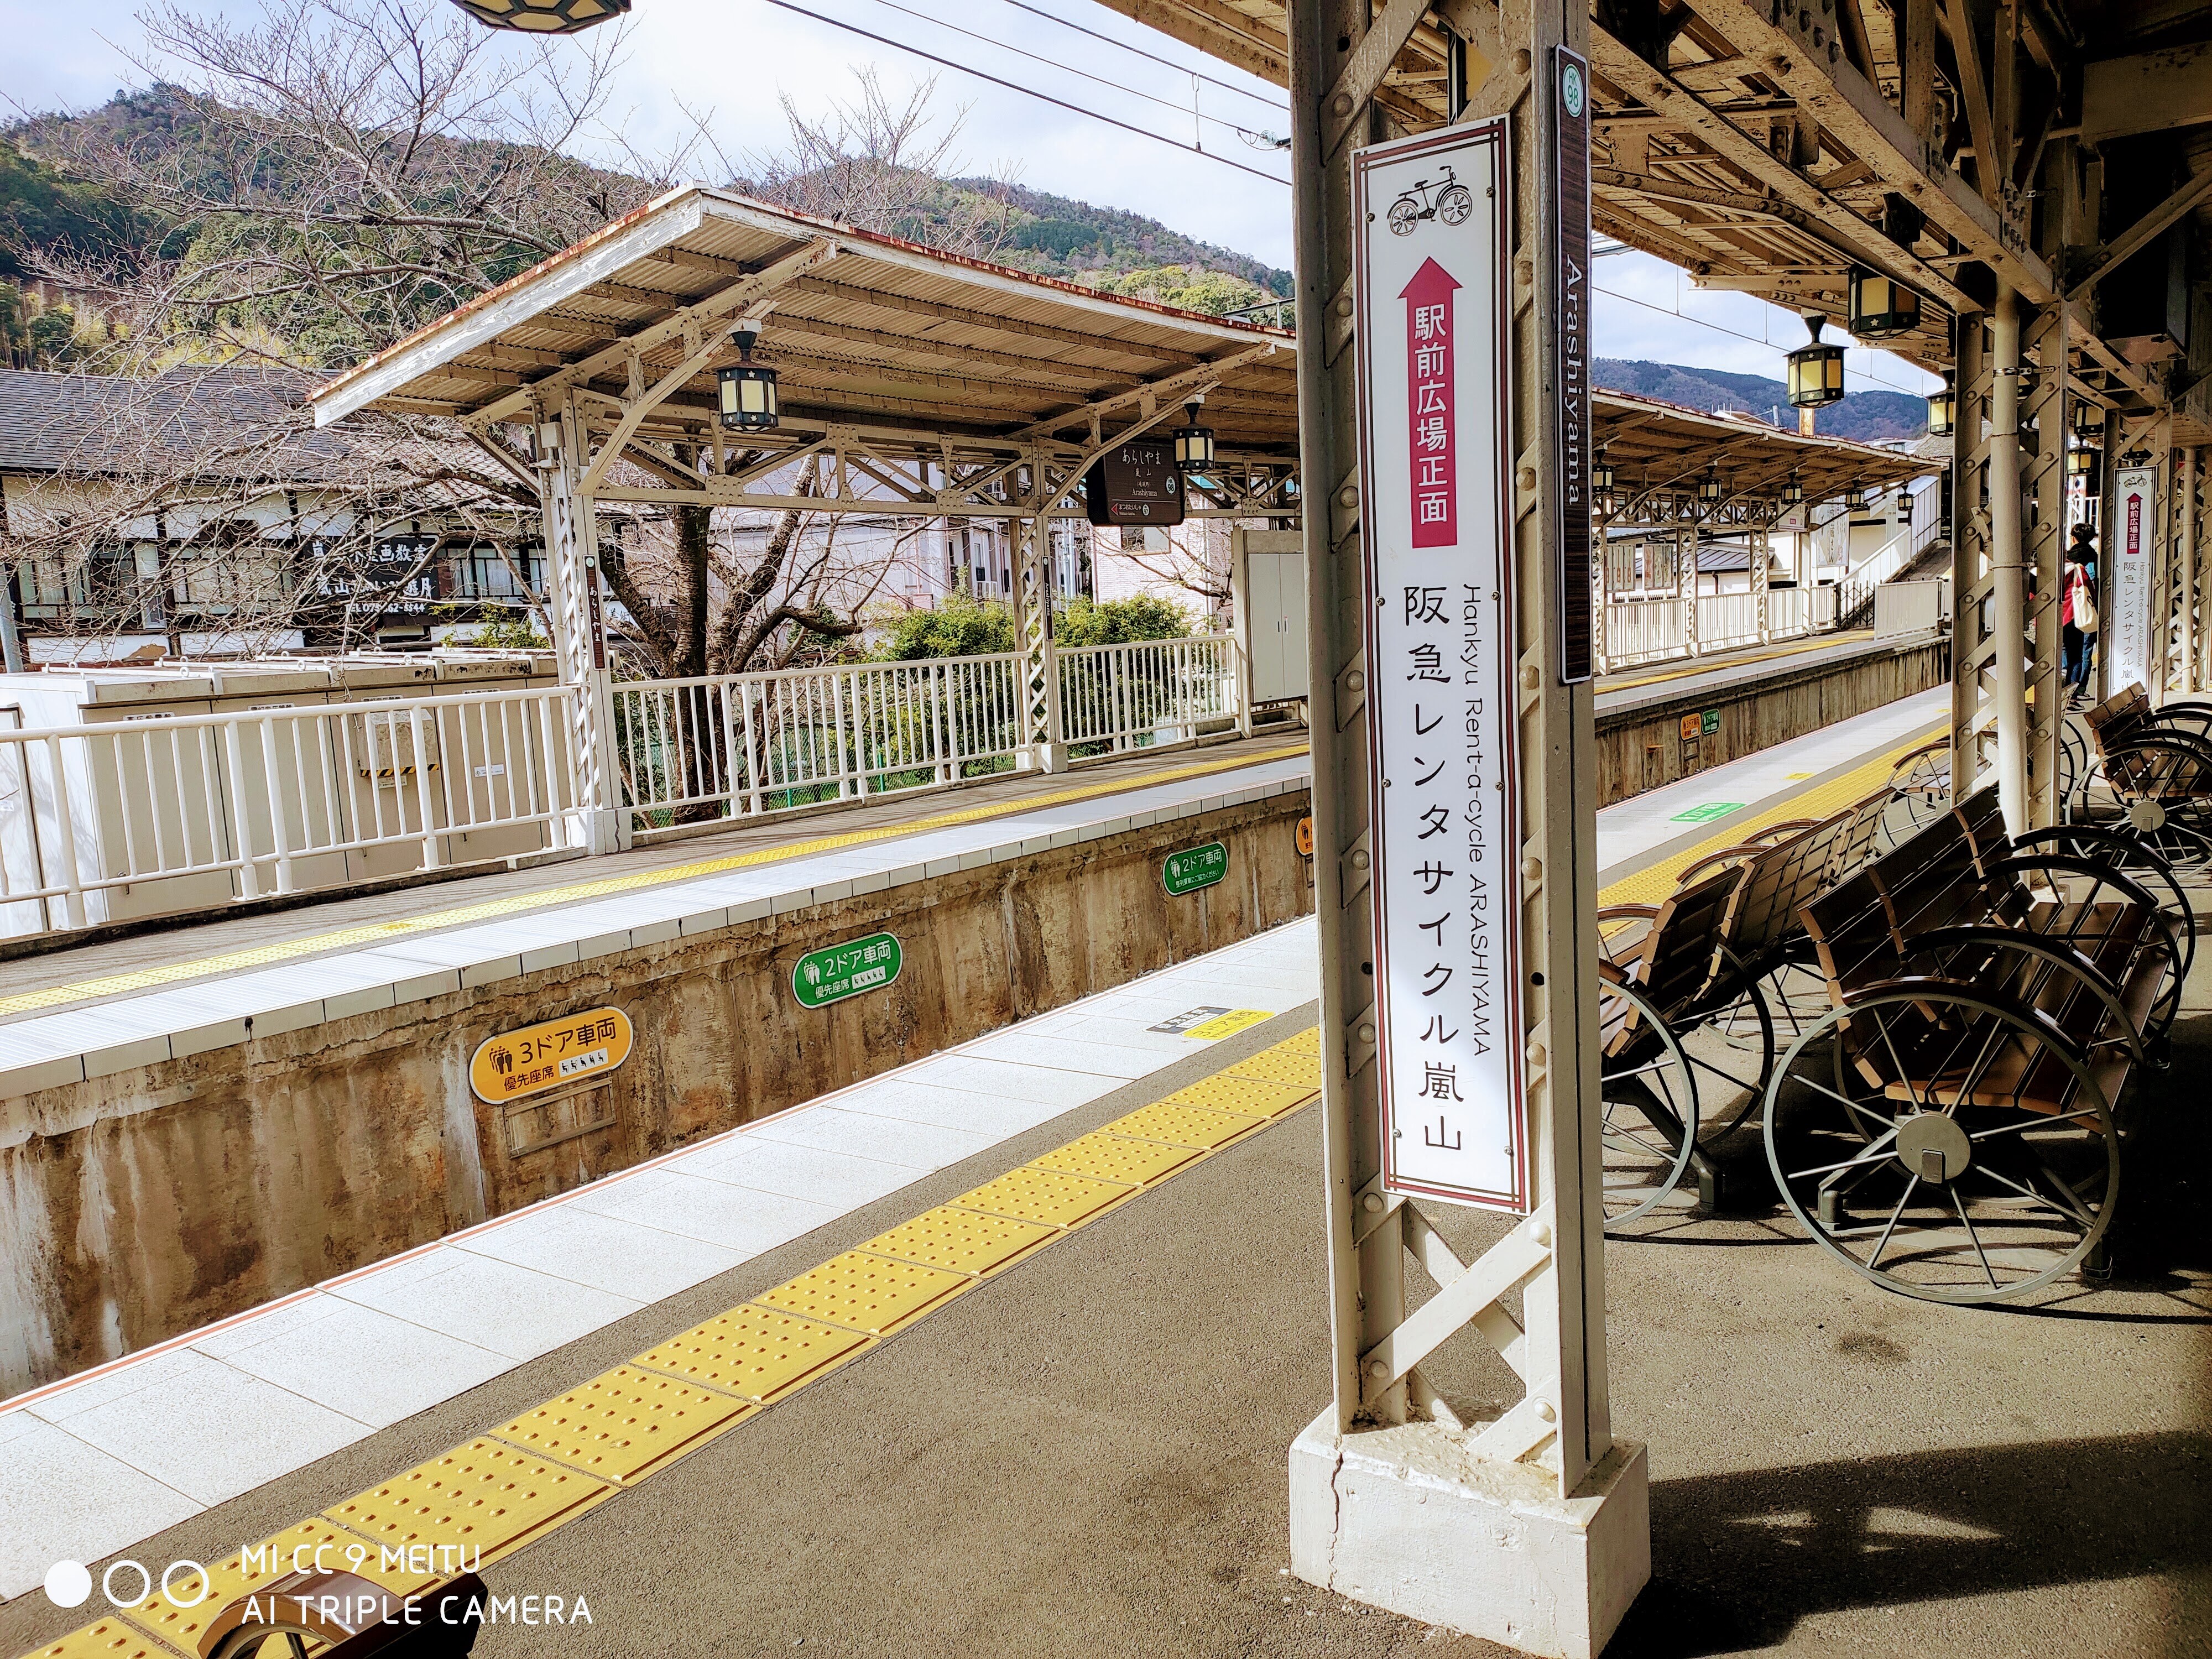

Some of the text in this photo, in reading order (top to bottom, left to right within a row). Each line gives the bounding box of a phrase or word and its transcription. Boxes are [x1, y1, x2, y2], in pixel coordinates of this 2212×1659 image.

[1568, 70, 1577, 87] HK
[1568, 85, 1579, 107] 98
[1564, 254, 1582, 505] Arashiyama
[1414, 303, 1448, 524] 駅前広場正面
[1122, 447, 1162, 466] あらしやま
[1131, 488, 1157, 497] Arashiyama
[2128, 502, 2139, 550] 駅前広場正面
[589, 586, 601, 642] あらしやま
[1460, 583, 1491, 1056] Hankyu Rent-a-cycle ARASHIYAMA
[1182, 848, 1222, 872] 2ドア車両
[1404, 586, 1464, 1150] 阪急レンタサイクル嵐山
[825, 940, 891, 977] 2ドア車両
[815, 978, 849, 999] 優先座席
[1193, 1010, 1258, 1037] 3ドア車両
[519, 1016, 616, 1064] 3ドア車両
[504, 1065, 555, 1092] 優先座席
